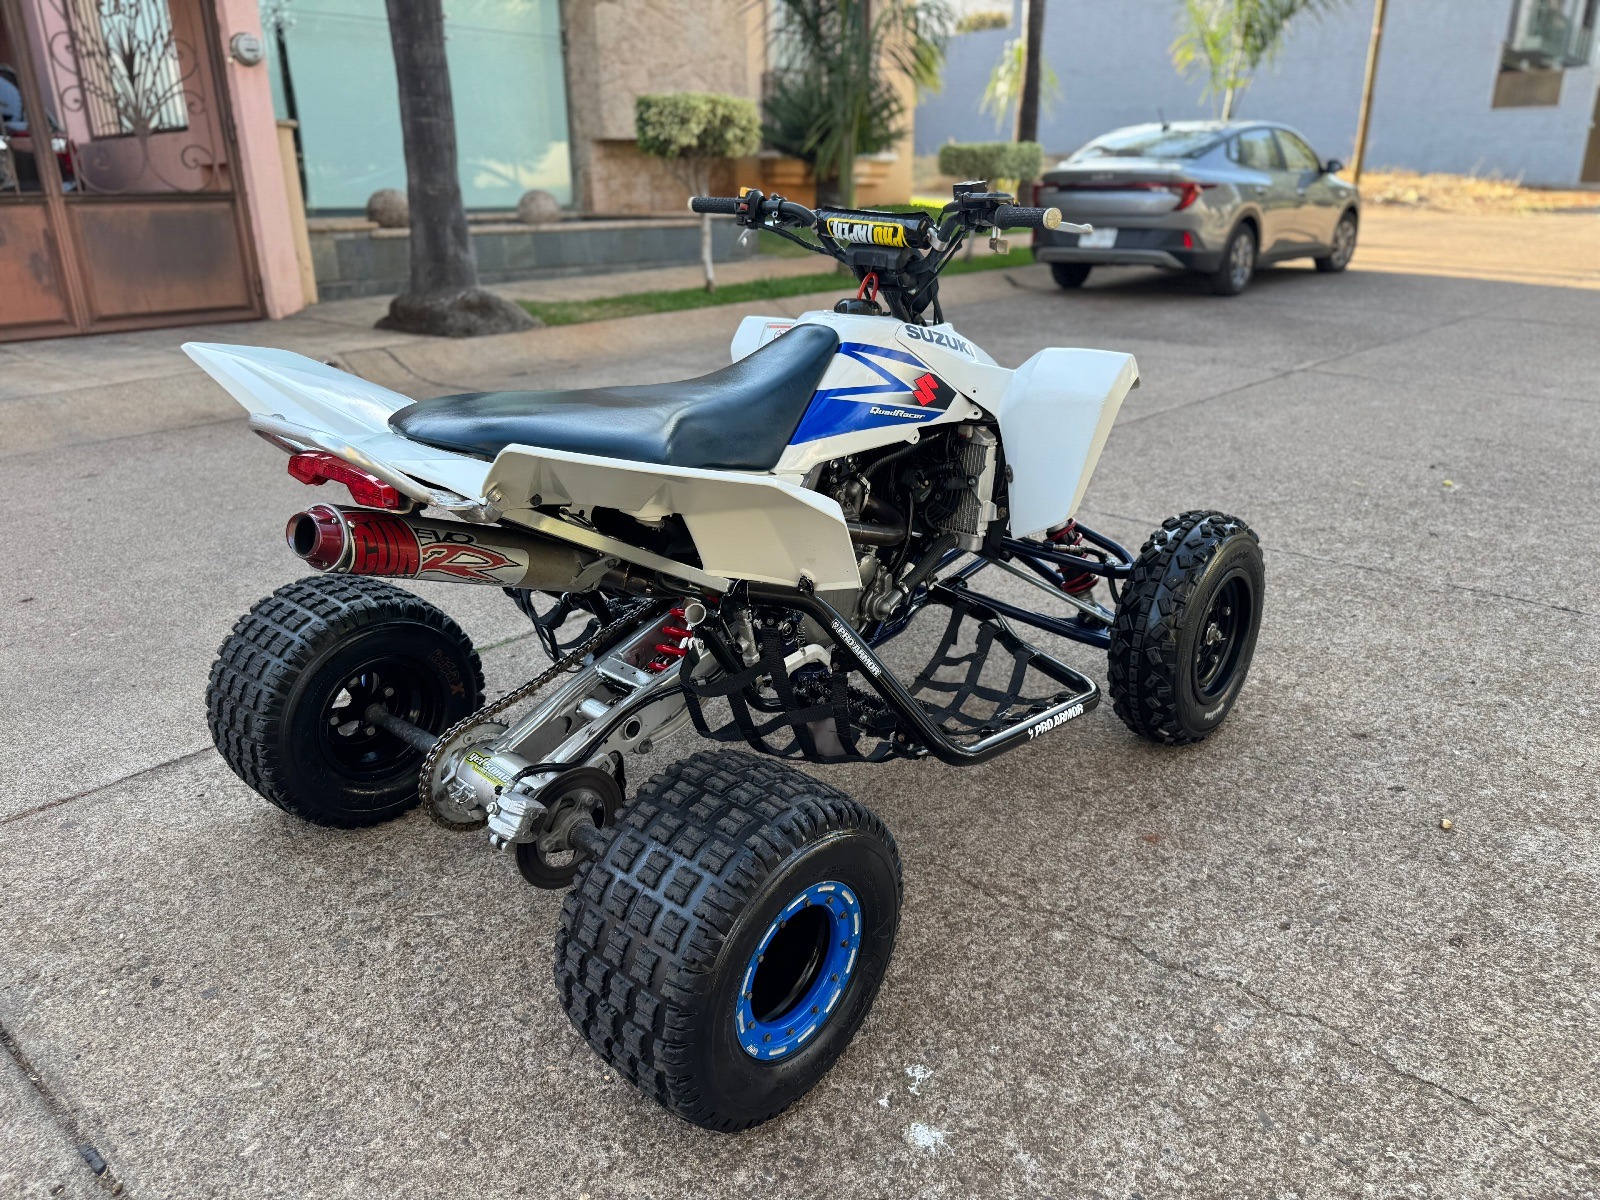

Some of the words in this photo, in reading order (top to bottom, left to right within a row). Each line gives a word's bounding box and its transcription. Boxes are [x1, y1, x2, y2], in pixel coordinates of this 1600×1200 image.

[869, 406, 926, 419] QuadRacer
[836, 624, 856, 648] PRO
[852, 641, 881, 677] ARMOR
[1035, 718, 1053, 737] PRO
[1054, 703, 1084, 728] ARMOR
